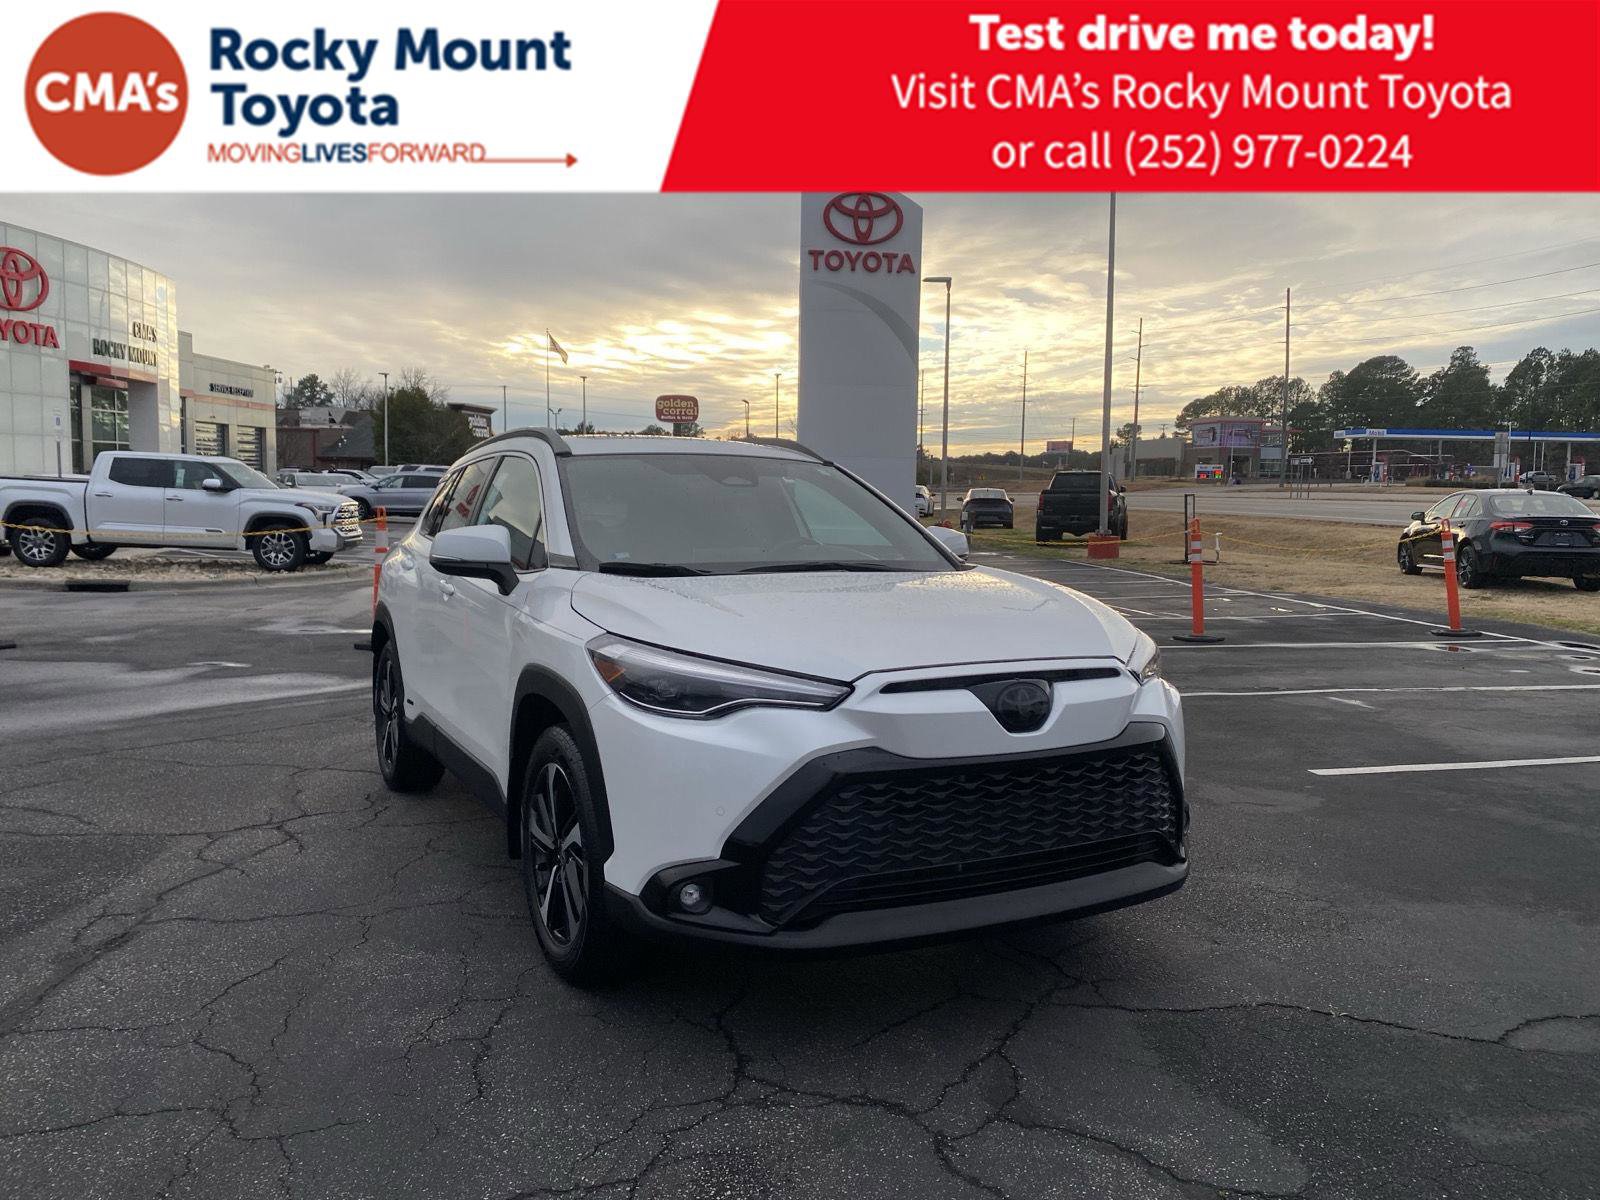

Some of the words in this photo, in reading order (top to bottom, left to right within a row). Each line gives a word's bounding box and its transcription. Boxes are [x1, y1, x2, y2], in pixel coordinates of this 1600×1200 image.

[808, 250, 915, 274] TOYOTA
[93, 338, 126, 360] ROCKY
[128, 346, 157, 367] MOUNT
[656, 399, 694, 410] golden
[663, 407, 698, 416] corral
